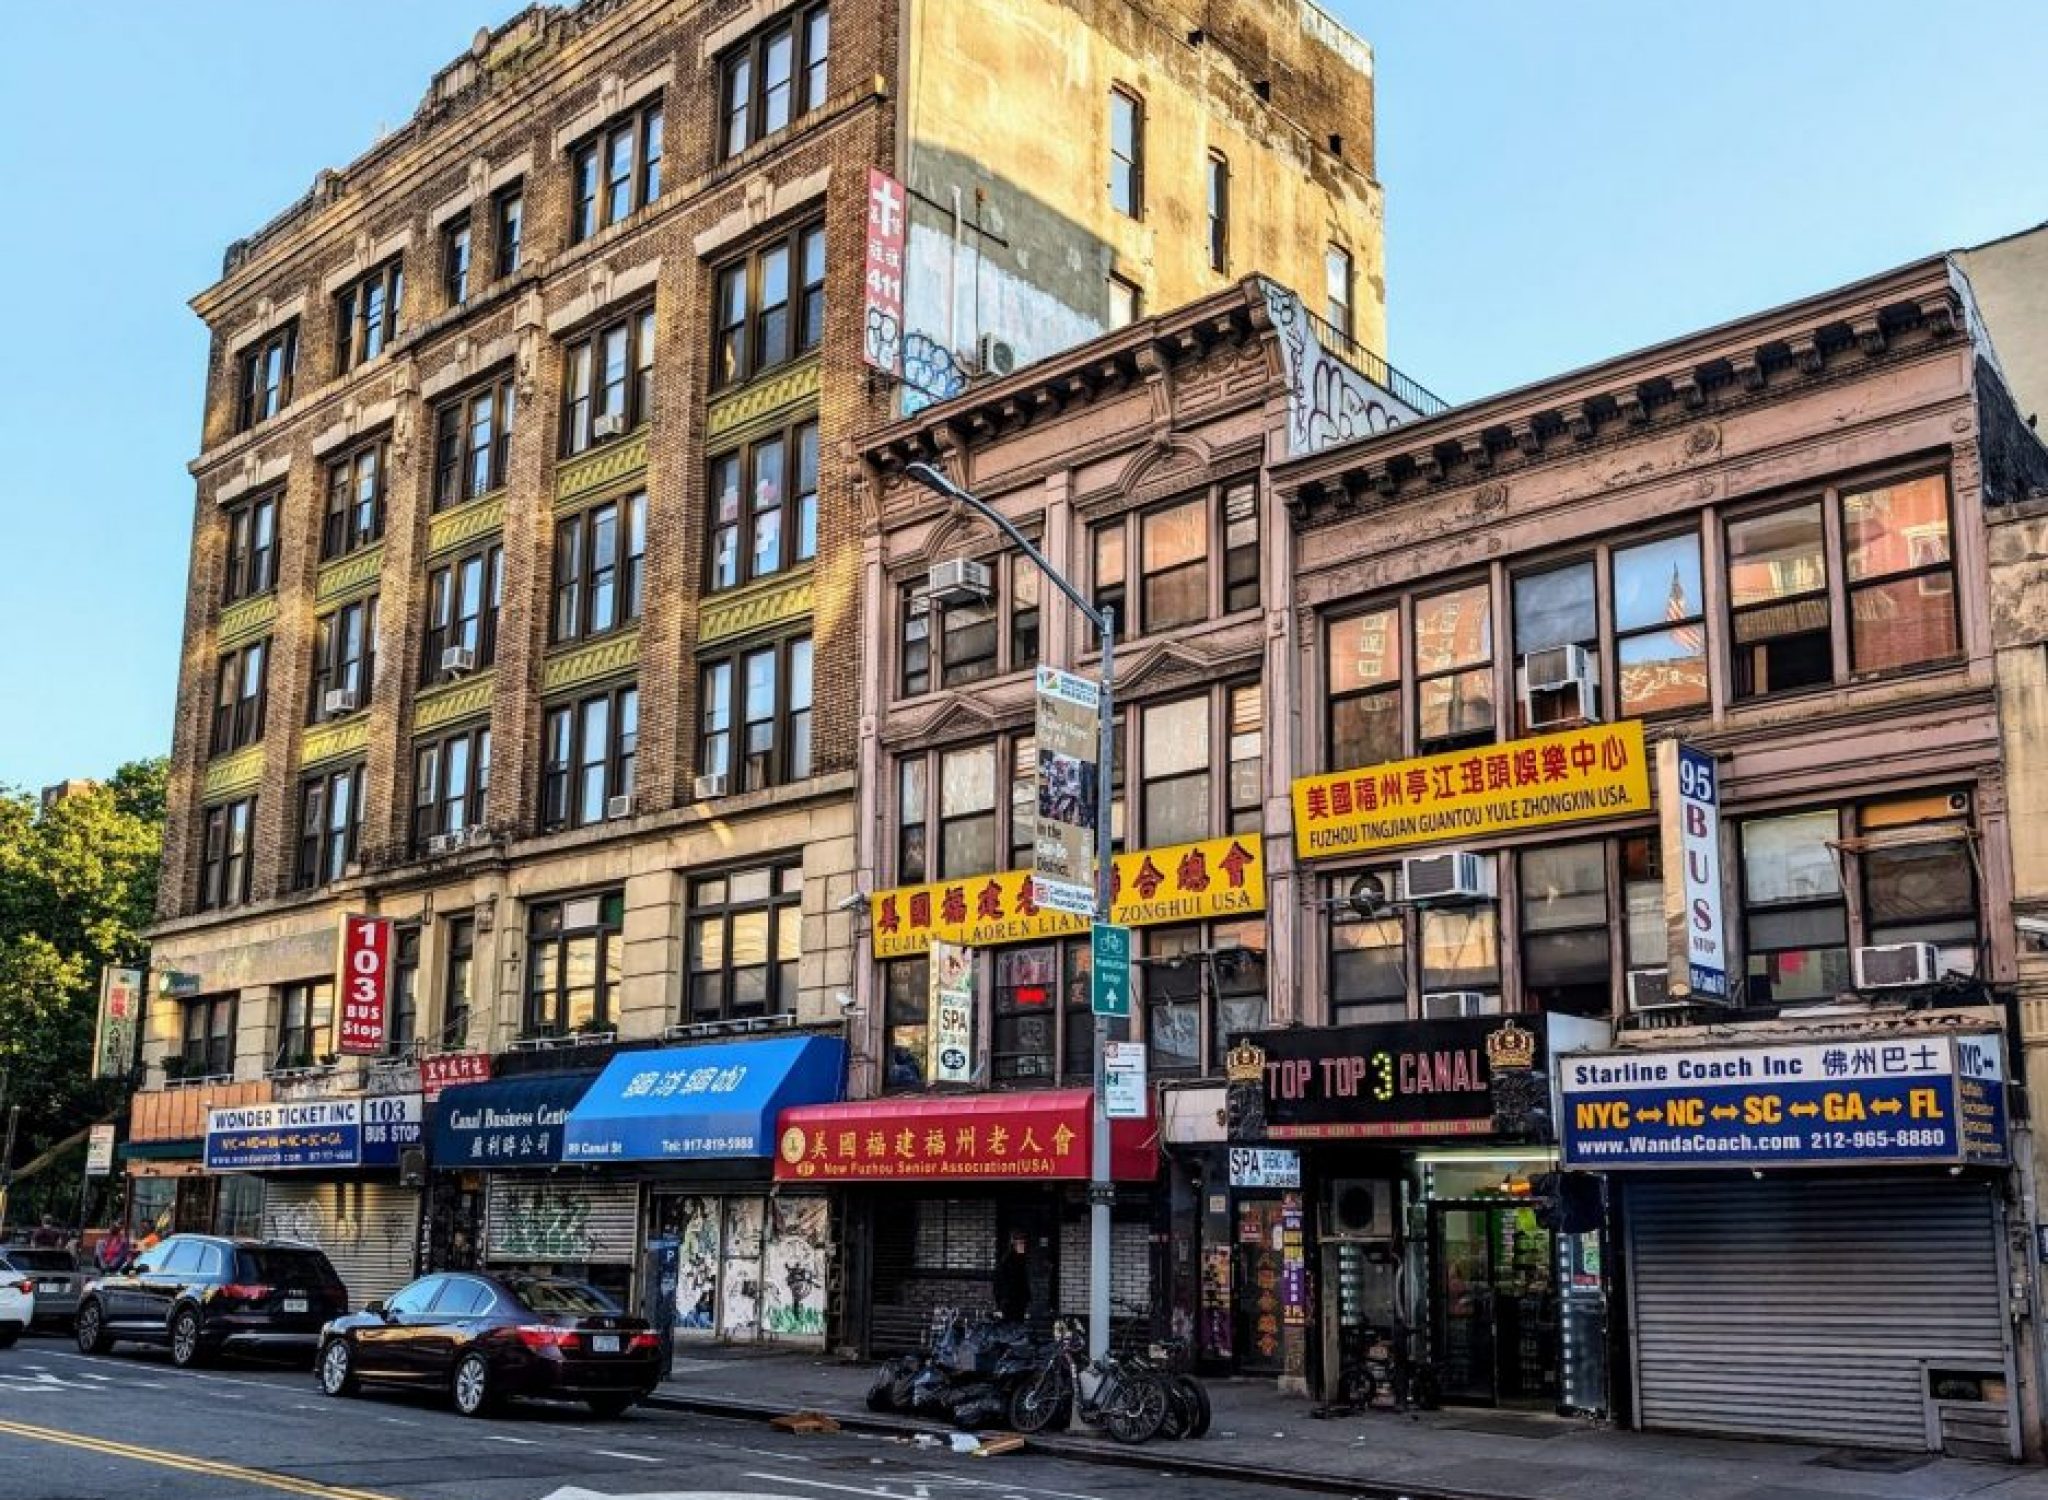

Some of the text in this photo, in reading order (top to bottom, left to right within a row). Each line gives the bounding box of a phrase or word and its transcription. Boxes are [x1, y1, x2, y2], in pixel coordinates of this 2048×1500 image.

[1680, 759, 1713, 801] 95
[1309, 825, 1358, 849] FUZHOU
[1360, 817, 1418, 843] TINGJIAN
[1419, 806, 1482, 834] GUANTOU
[1484, 800, 1520, 824] YULE
[1522, 788, 1596, 818] ZHONGXIN
[1118, 900, 1202, 923] ZONGHUI
[1211, 891, 1252, 911] USA
[346, 1004, 380, 1020] BUS
[942, 1007, 968, 1033] SPA
[342, 1020, 382, 1039] Stop
[1266, 1050, 1489, 1101] TOP TOP 3 CANAL
[1575, 1043, 1939, 1085] Starline Coach Inc 佛州巴士
[215, 1103, 356, 1129] WONDER TICKET INC
[369, 1101, 406, 1121] 103
[1576, 1101, 1630, 1130] NYC
[1666, 1097, 1705, 1127] NC
[1743, 1095, 1782, 1125] SC
[1823, 1092, 1867, 1122] GA
[1909, 1088, 1944, 1118] FL
[364, 1125, 420, 1142] BUS STOP
[810, 1121, 1076, 1158] 美國福建福州老人會
[1577, 1133, 1802, 1156] www.WandaCoach.com
[1811, 1128, 1945, 1150] 212-965-8880
[850, 1160, 894, 1175] Fuzhou
[896, 1160, 938, 1174] Senior
[1232, 1149, 1261, 1177] SPA
[666, 1249, 676, 1263] P
